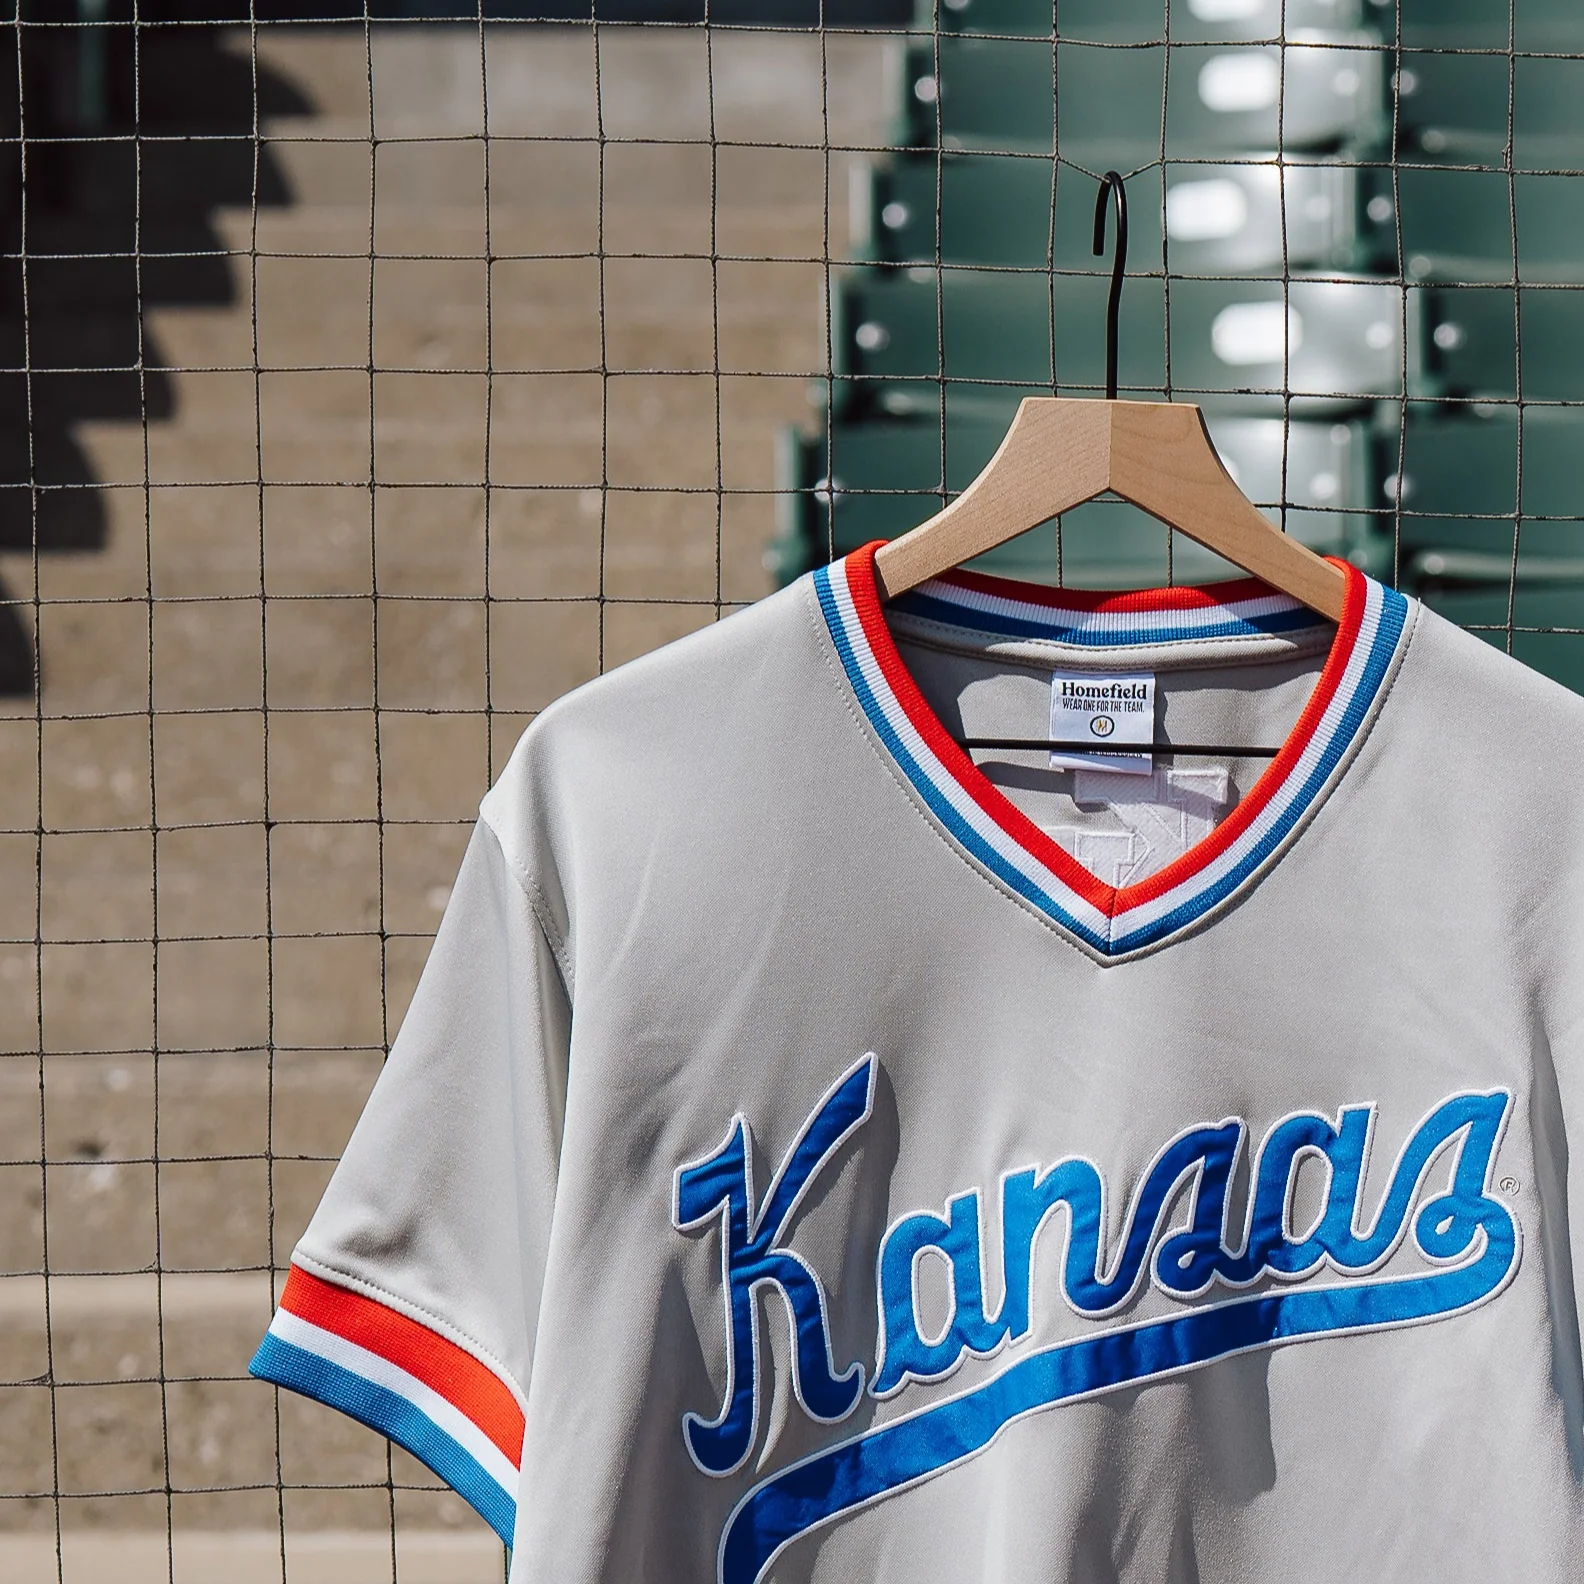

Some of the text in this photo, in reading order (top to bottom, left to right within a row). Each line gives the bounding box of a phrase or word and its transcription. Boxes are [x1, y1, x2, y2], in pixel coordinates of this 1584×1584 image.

[1061, 682, 1147, 700] Homefield
[1063, 698, 1145, 713] WEAR ONE FOR THE TEAM.
[673, 1052, 1525, 1476] Kansas
